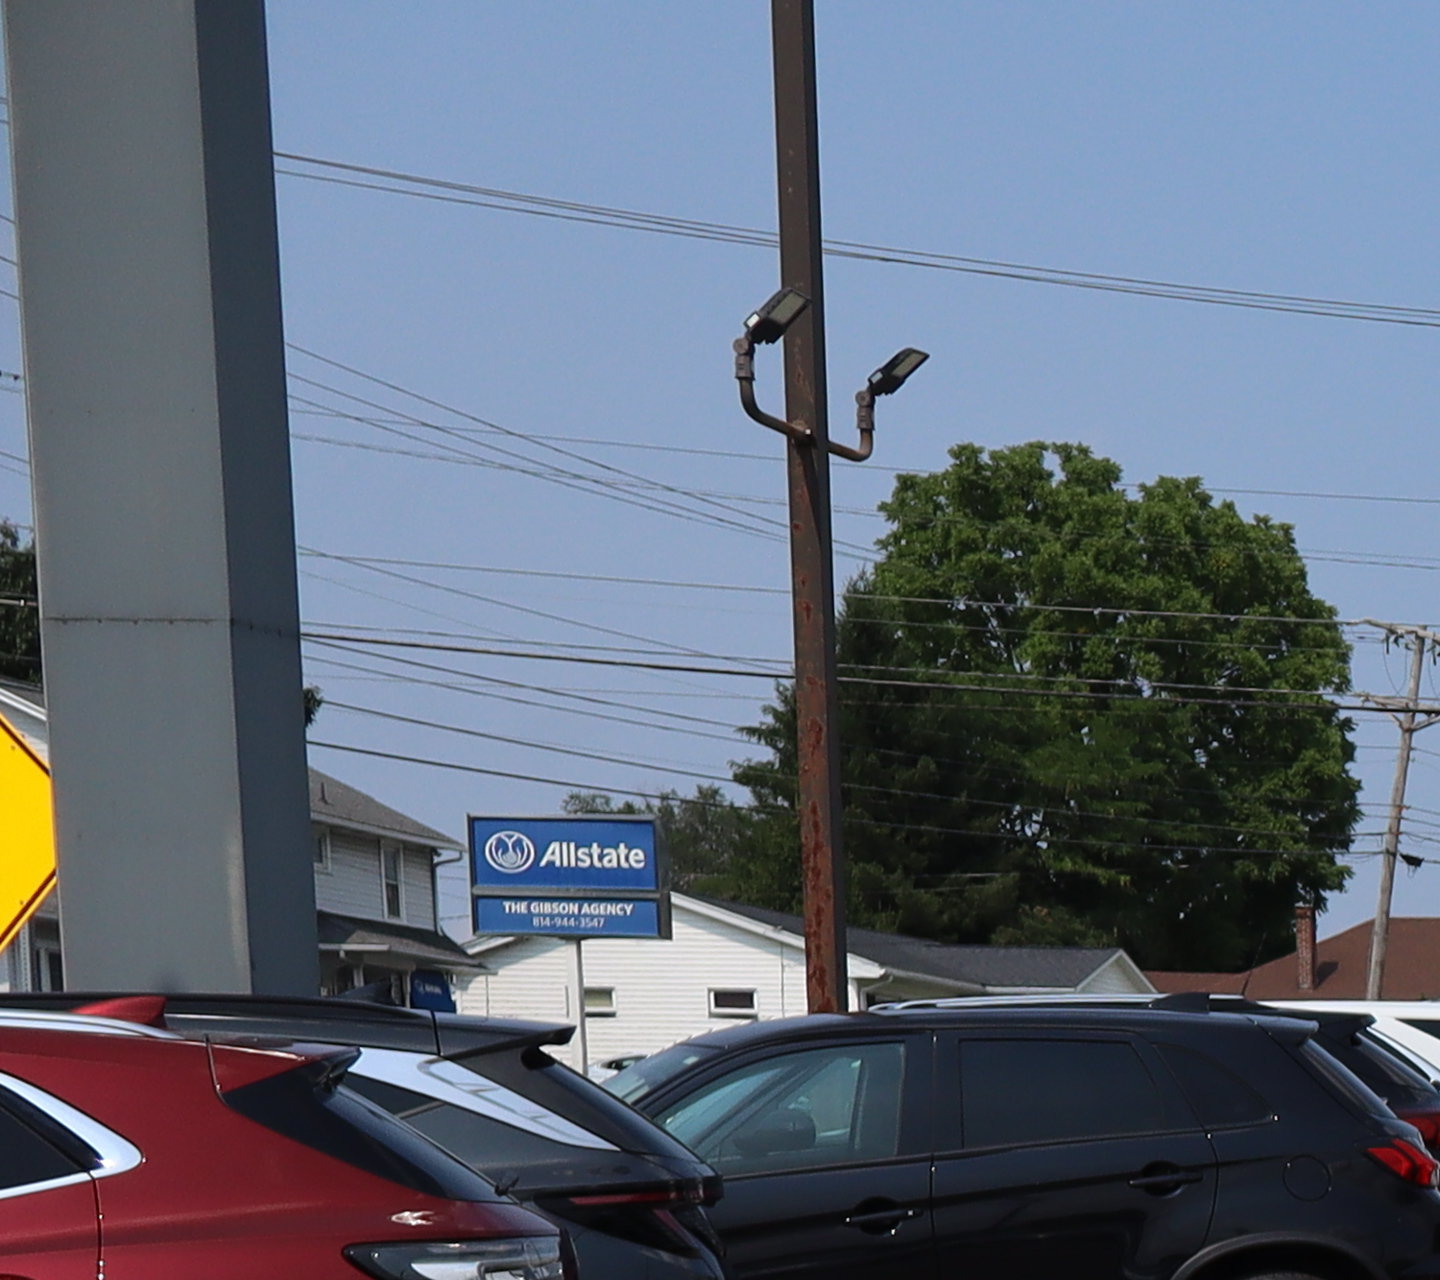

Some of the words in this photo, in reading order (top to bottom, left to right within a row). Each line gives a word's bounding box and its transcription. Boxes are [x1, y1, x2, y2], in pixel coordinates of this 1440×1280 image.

[539, 841, 645, 869] Allstate
[503, 901, 528, 914] THE
[530, 902, 579, 915] GIBSON
[580, 902, 633, 916] AGENCY
[532, 916, 604, 928] 814-944-3547
